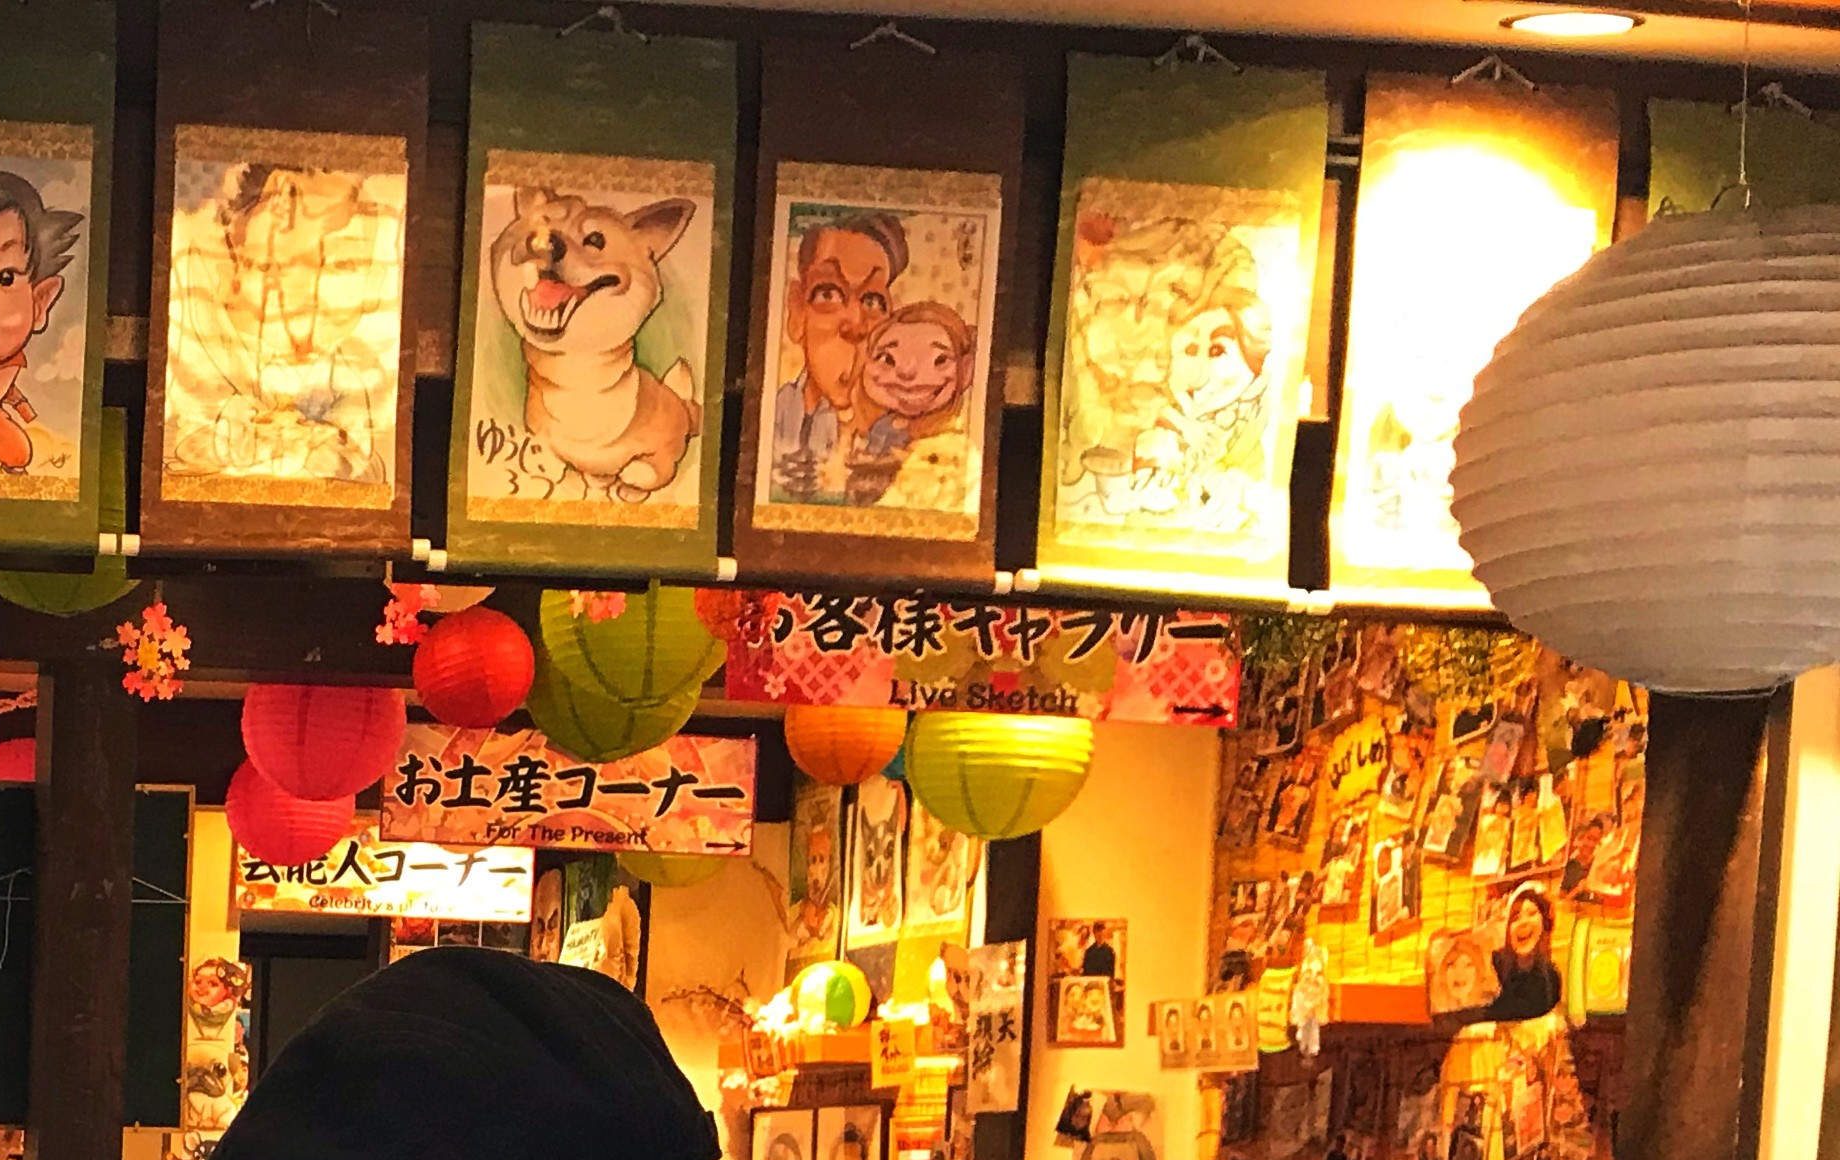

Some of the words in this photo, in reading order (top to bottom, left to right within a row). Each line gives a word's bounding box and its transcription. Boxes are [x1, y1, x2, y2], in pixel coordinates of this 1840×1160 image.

[888, 678, 958, 708] Live
[966, 683, 1079, 714] Sketch
[394, 752, 746, 818] お土産コーナー
[485, 822, 521, 841] For
[528, 824, 566, 842] The
[571, 827, 648, 846] Present
